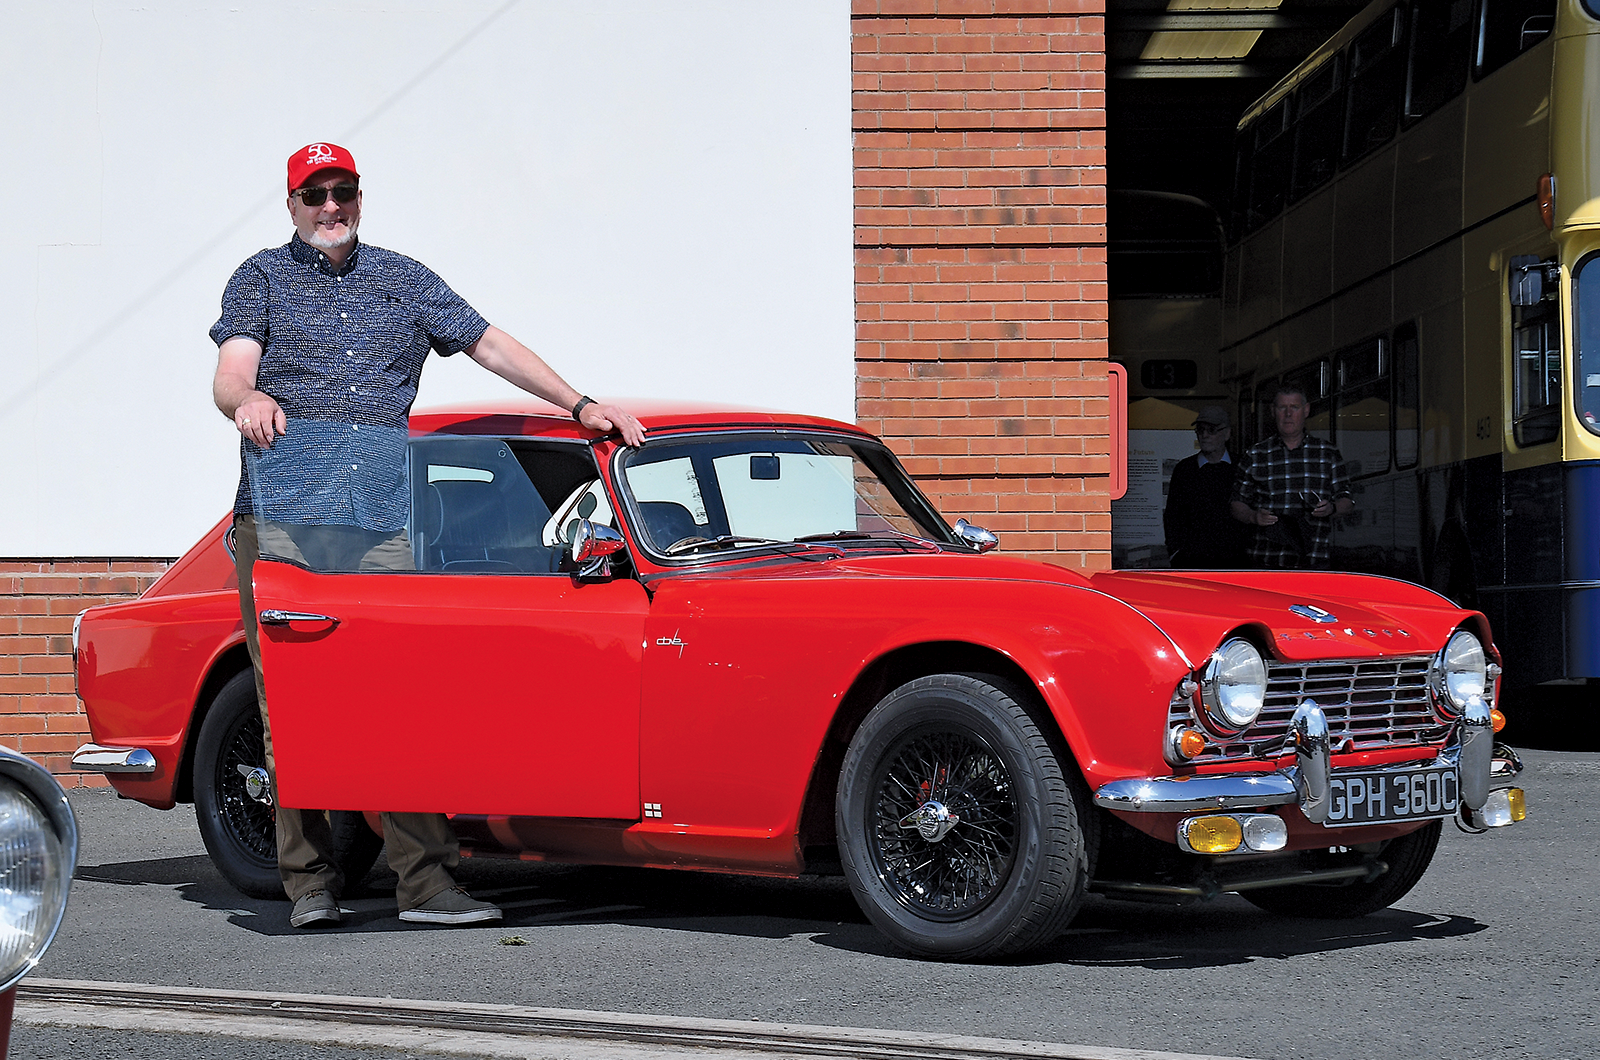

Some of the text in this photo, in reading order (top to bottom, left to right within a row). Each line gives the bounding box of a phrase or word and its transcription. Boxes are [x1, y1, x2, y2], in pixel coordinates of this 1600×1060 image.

[308, 144, 332, 159] 50
[1150, 361, 1176, 386] 13
[1328, 771, 1456, 820] GPH 360C
